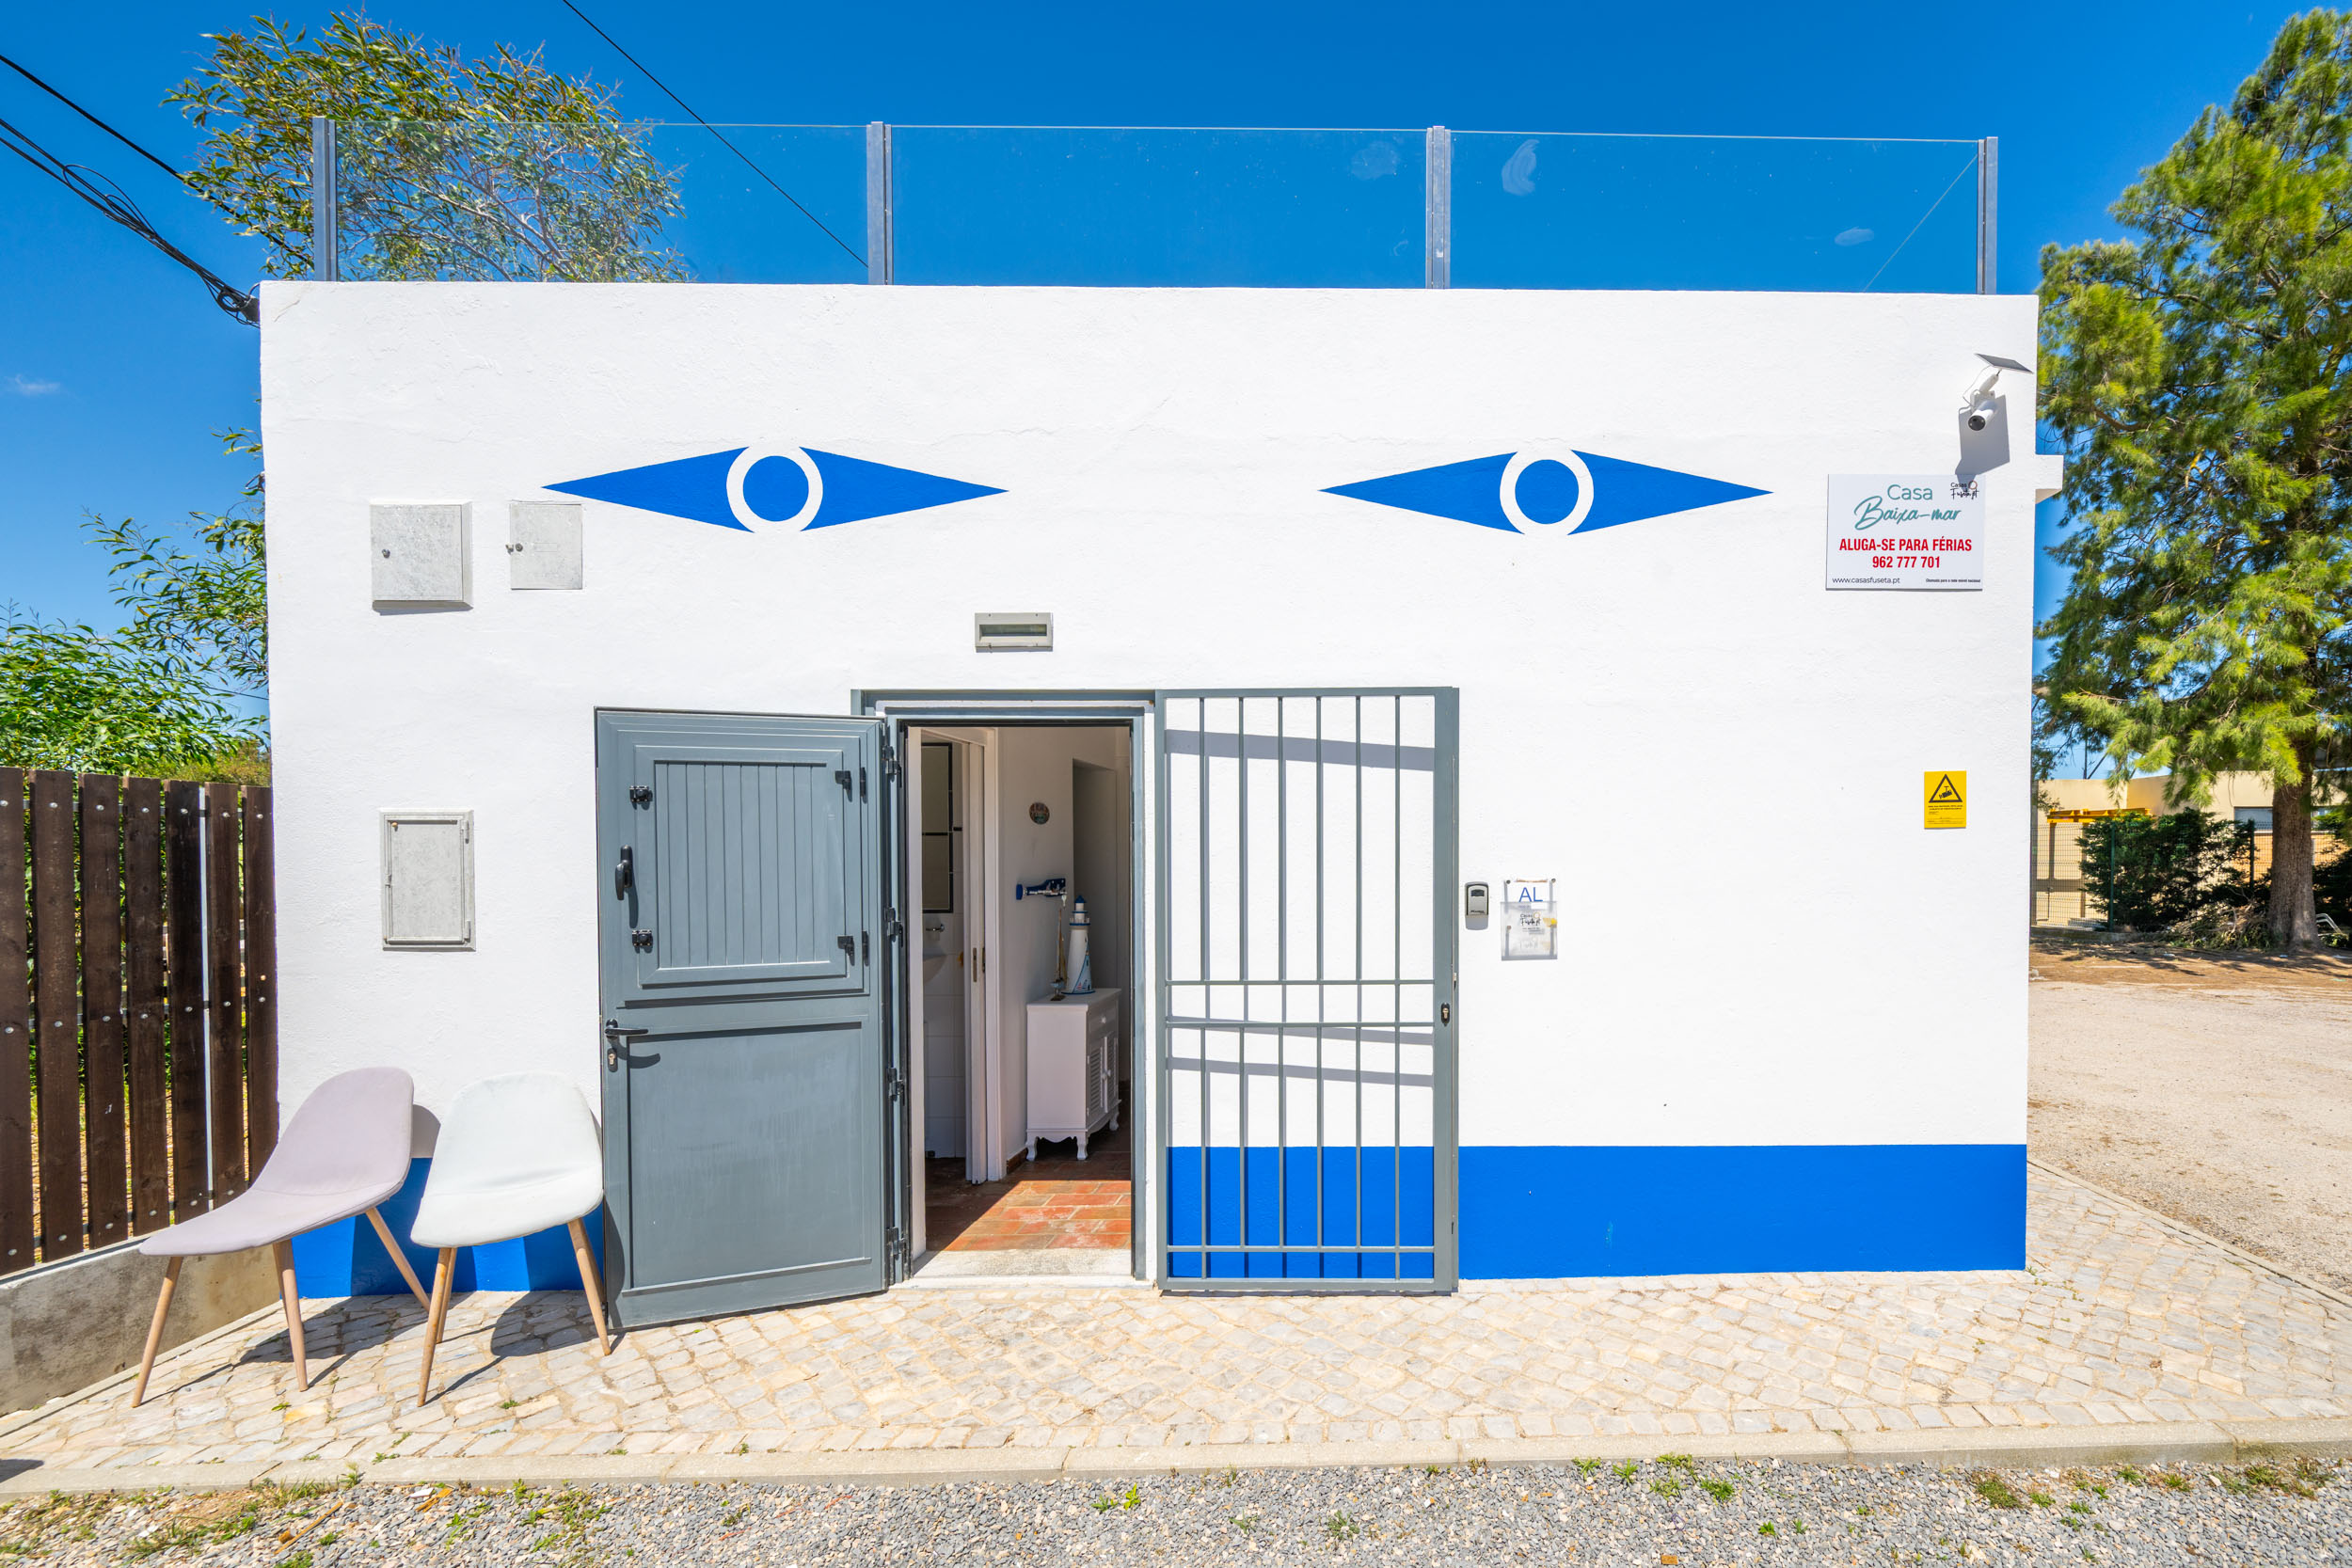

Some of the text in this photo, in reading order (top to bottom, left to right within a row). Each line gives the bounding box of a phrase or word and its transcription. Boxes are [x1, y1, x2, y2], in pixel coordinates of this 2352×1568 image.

[1887, 484, 1932, 500] Casa
[1853, 496, 1962, 531] Baixa-mar
[1839, 536, 1972, 551] ALUGA-SE PARA FÉRIAS
[1872, 556, 1940, 568] 962 777 701
[1832, 576, 1900, 584] www.casasfuseta.pt
[1518, 887, 1543, 902] AL
